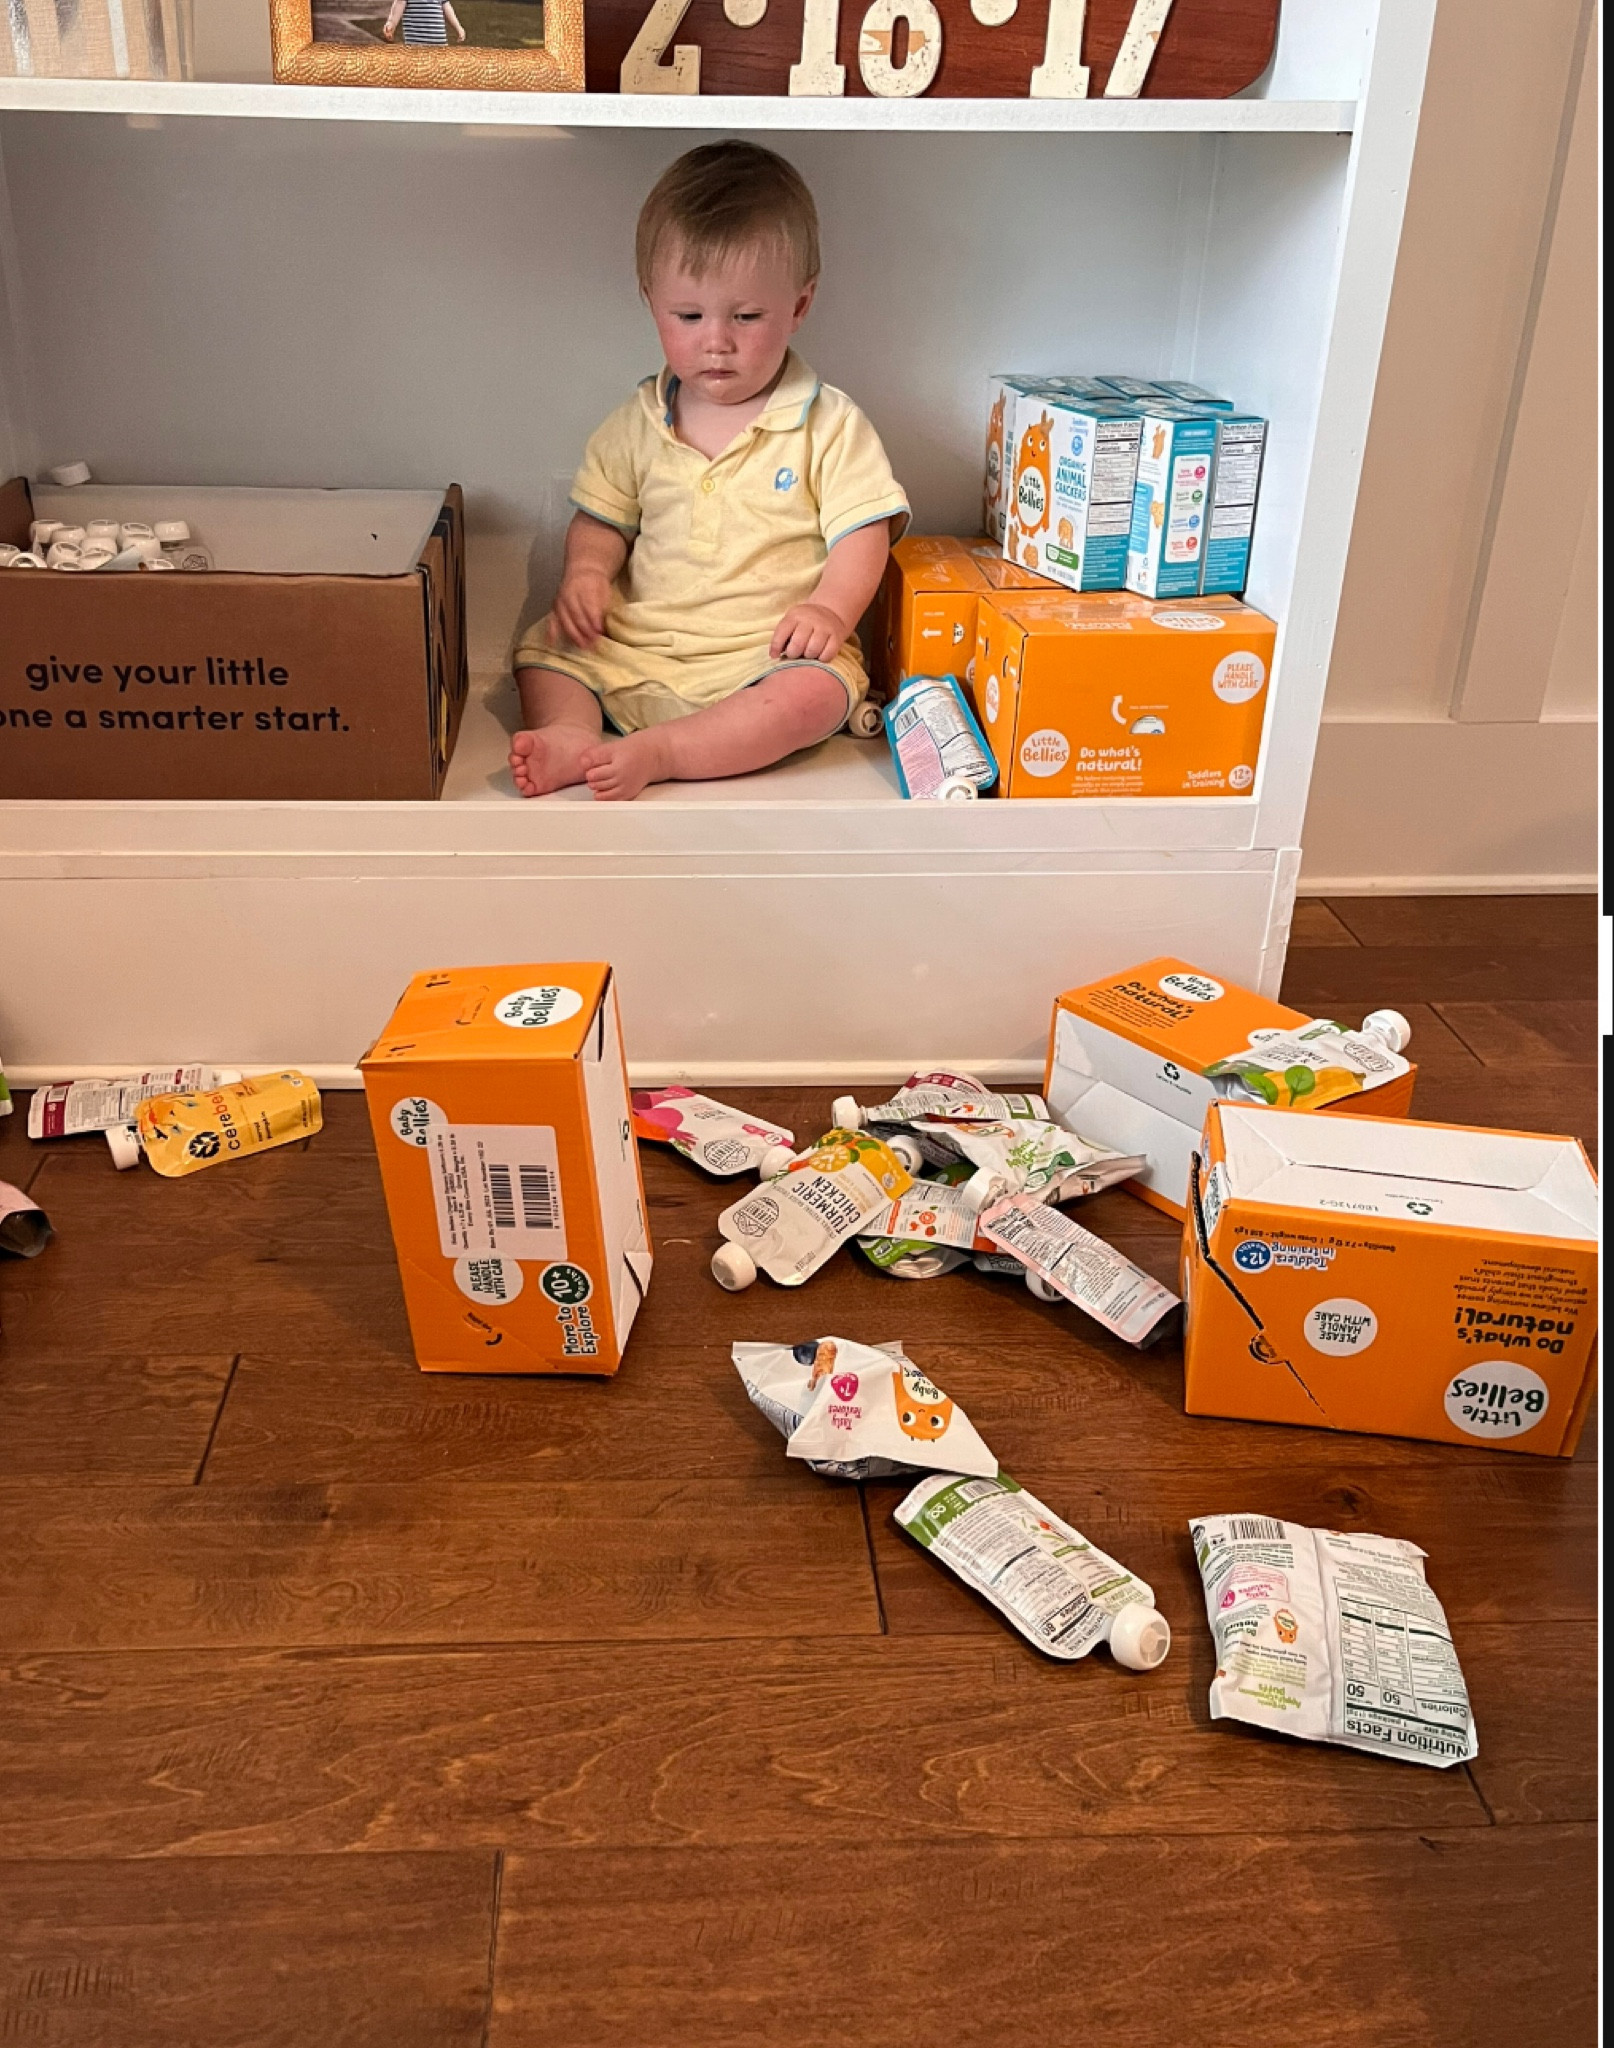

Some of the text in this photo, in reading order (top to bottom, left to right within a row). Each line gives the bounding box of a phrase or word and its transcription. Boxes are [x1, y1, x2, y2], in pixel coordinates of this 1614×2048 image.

[1024, 475, 1041, 491] Little
[1056, 467, 1086, 488] ANIMAL
[1019, 486, 1044, 511] Bellies
[1055, 481, 1086, 501] CRACKERS
[26, 655, 289, 692] give your little
[1224, 671, 1255, 680] HANDLE
[1227, 663, 1254, 672] PLEASE
[1218, 680, 1259, 689] WITH CARE
[65, 709, 87, 729] a
[100, 706, 244, 730] smarter
[255, 706, 350, 732] start.
[1032, 737, 1060, 748] Little
[1080, 745, 1140, 758] Do what's
[1023, 747, 1068, 763] Bellies
[1076, 758, 1142, 771] natural!
[1187, 769, 1221, 779] Toddlers
[1192, 779, 1225, 788] training
[1164, 976, 1214, 1001] Bellies
[1188, 976, 1215, 991] Baby
[504, 994, 535, 1018] Baby
[522, 986, 561, 1027] Bellies
[1113, 985, 1189, 1020] natural!
[1128, 981, 1147, 992] Do
[1149, 990, 1194, 1013] what's
[398, 1108, 412, 1136] Baby
[791, 1182, 844, 1235] TURMERIC
[811, 1176, 861, 1225] CHICKEN
[1241, 1250, 1266, 1265] 12+
[1271, 1242, 1334, 1258] in training
[1275, 1253, 1327, 1268] Toddlers
[468, 1261, 482, 1292] PLEASE
[480, 1258, 494, 1294] HANDLE
[551, 1271, 572, 1297] 10+
[495, 1278, 508, 1299] WITH
[1314, 1310, 1371, 1326] WITH CARE
[1318, 1321, 1361, 1334] HANDLE
[1454, 1307, 1574, 1335] natural!
[558, 1306, 580, 1355] More to
[579, 1306, 599, 1355] Explore
[1319, 1331, 1358, 1343] PLEASE
[1457, 1326, 1564, 1354] Do what's
[911, 1381, 938, 1400] Baby
[1450, 1377, 1545, 1413] Bellies
[827, 1404, 861, 1418] Textures
[1462, 1404, 1522, 1427] Little
[830, 1415, 852, 1430] Tasty
[1040, 1621, 1057, 1638] 80
[1347, 1682, 1365, 1697] 50
[1383, 1691, 1402, 1706] 50
[1421, 1702, 1467, 1718] Calories
[1346, 1720, 1469, 1758] Nutrition Facts
